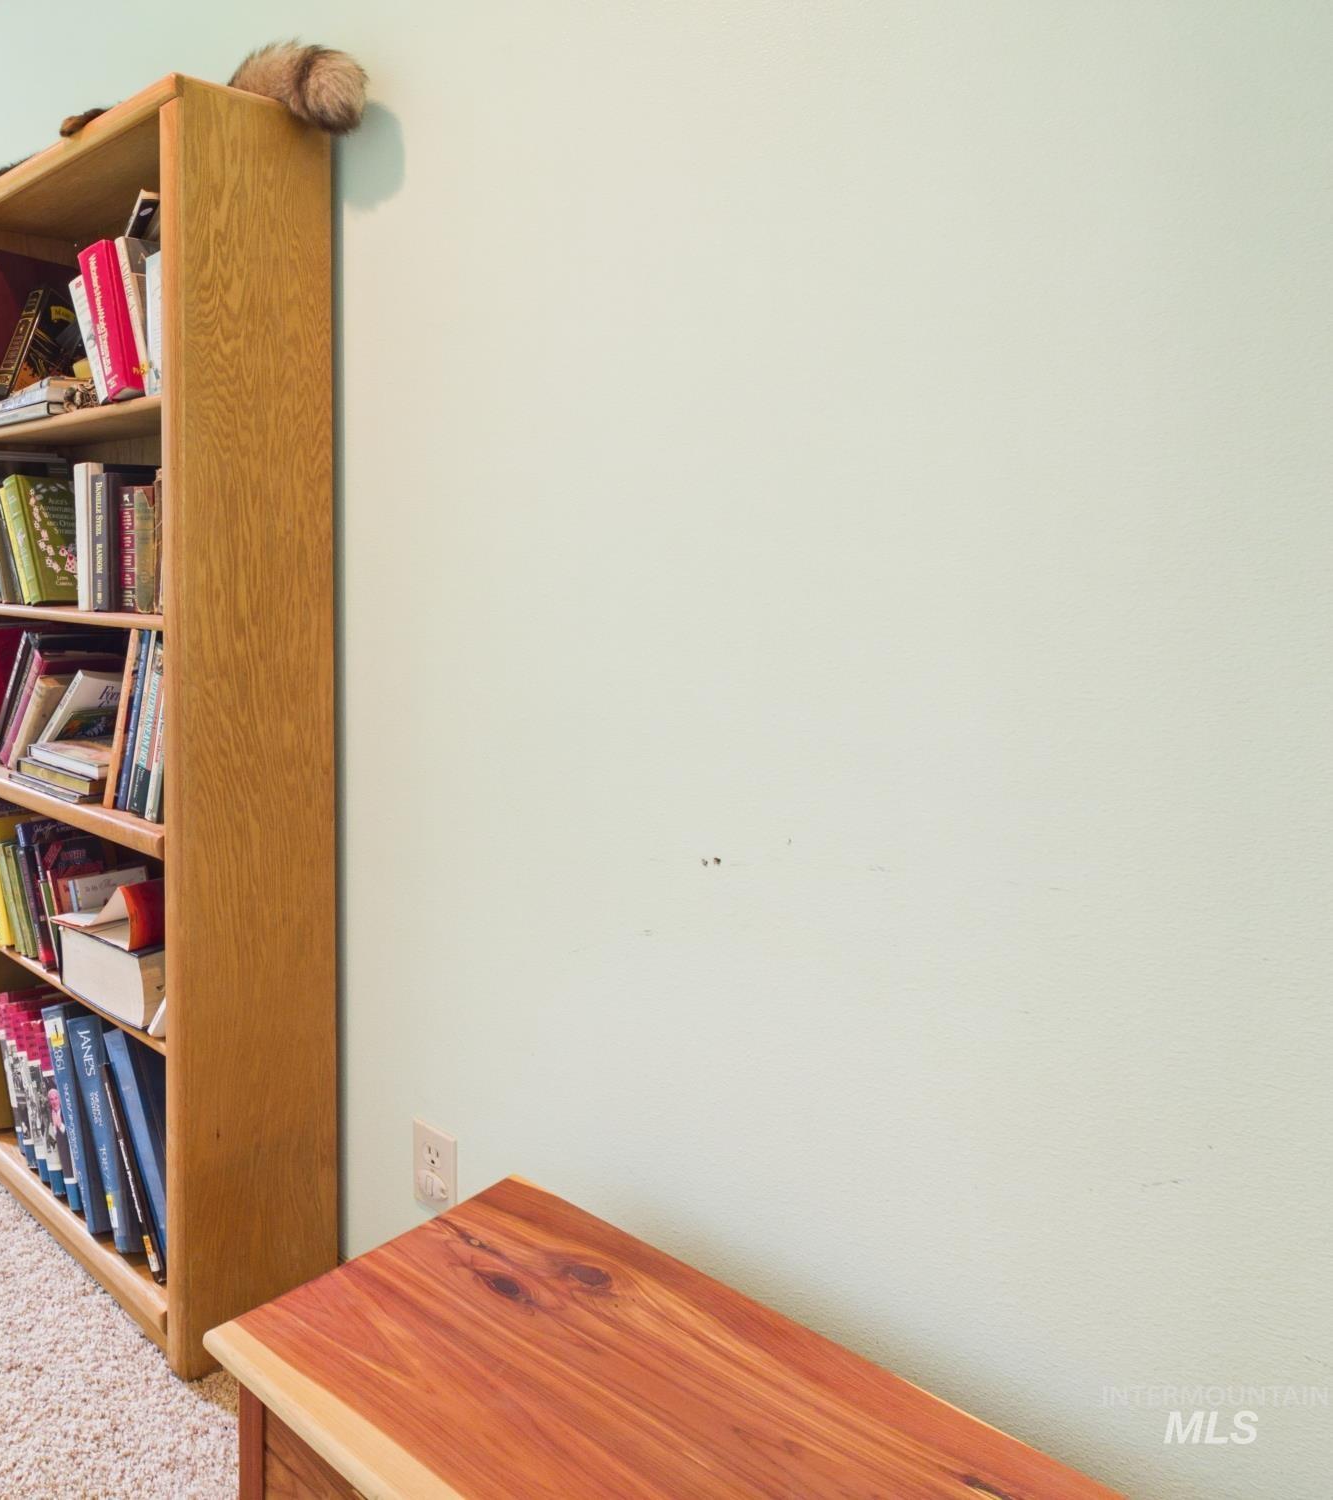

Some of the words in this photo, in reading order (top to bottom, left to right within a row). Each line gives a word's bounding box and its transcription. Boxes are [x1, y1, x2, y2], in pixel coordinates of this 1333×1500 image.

[94, 481, 103, 514] DANIELLE
[94, 514, 103, 536] STEEL
[95, 543, 103, 574] RANSOM
[127, 1170, 143, 1223] Photographer
